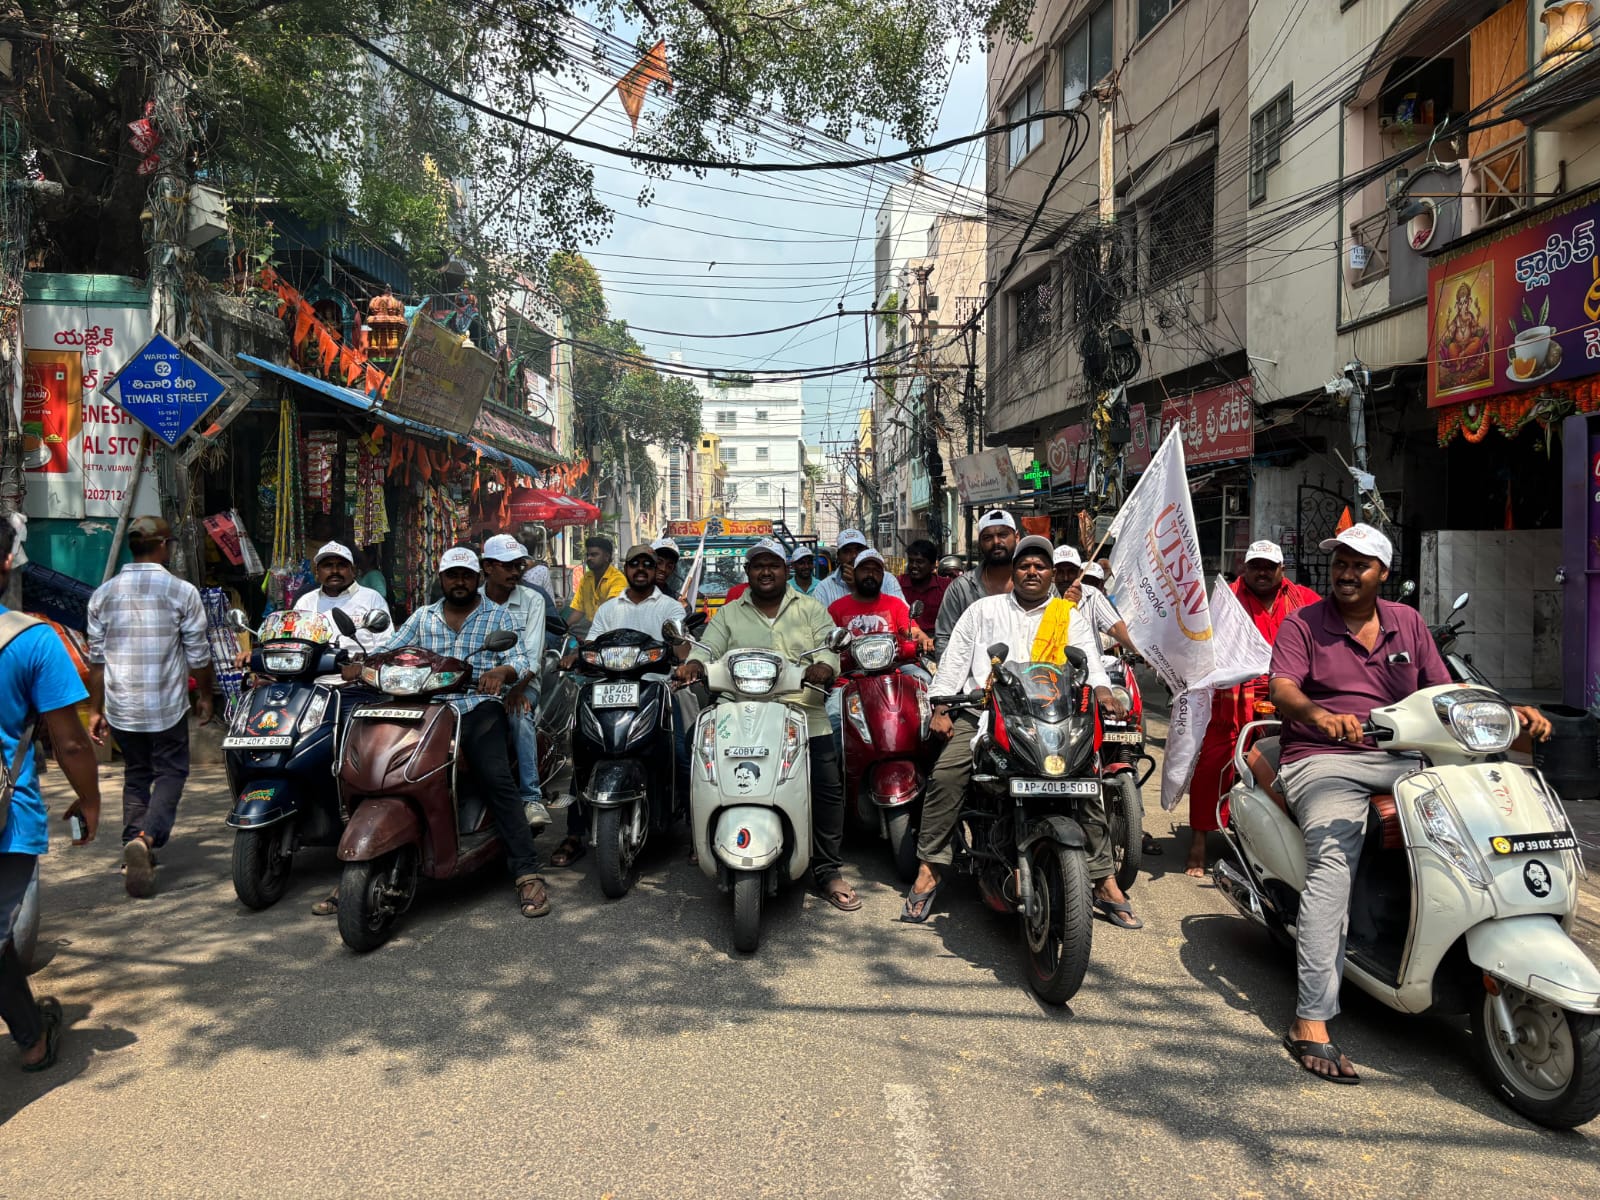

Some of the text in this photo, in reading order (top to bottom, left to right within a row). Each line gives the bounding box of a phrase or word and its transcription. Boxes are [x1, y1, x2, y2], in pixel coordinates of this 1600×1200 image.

[1515, 219, 1595, 292] క్లాసిక్
[156, 364, 170, 374] 52
[125, 393, 209, 404] TIWARI STREET
[1023, 470, 1051, 480] MEDICAL
[1154, 502, 1209, 615] UTSAV
[1140, 577, 1167, 618] greenko
[1513, 841, 1525, 852] AP
[1526, 840, 1539, 851] 39
